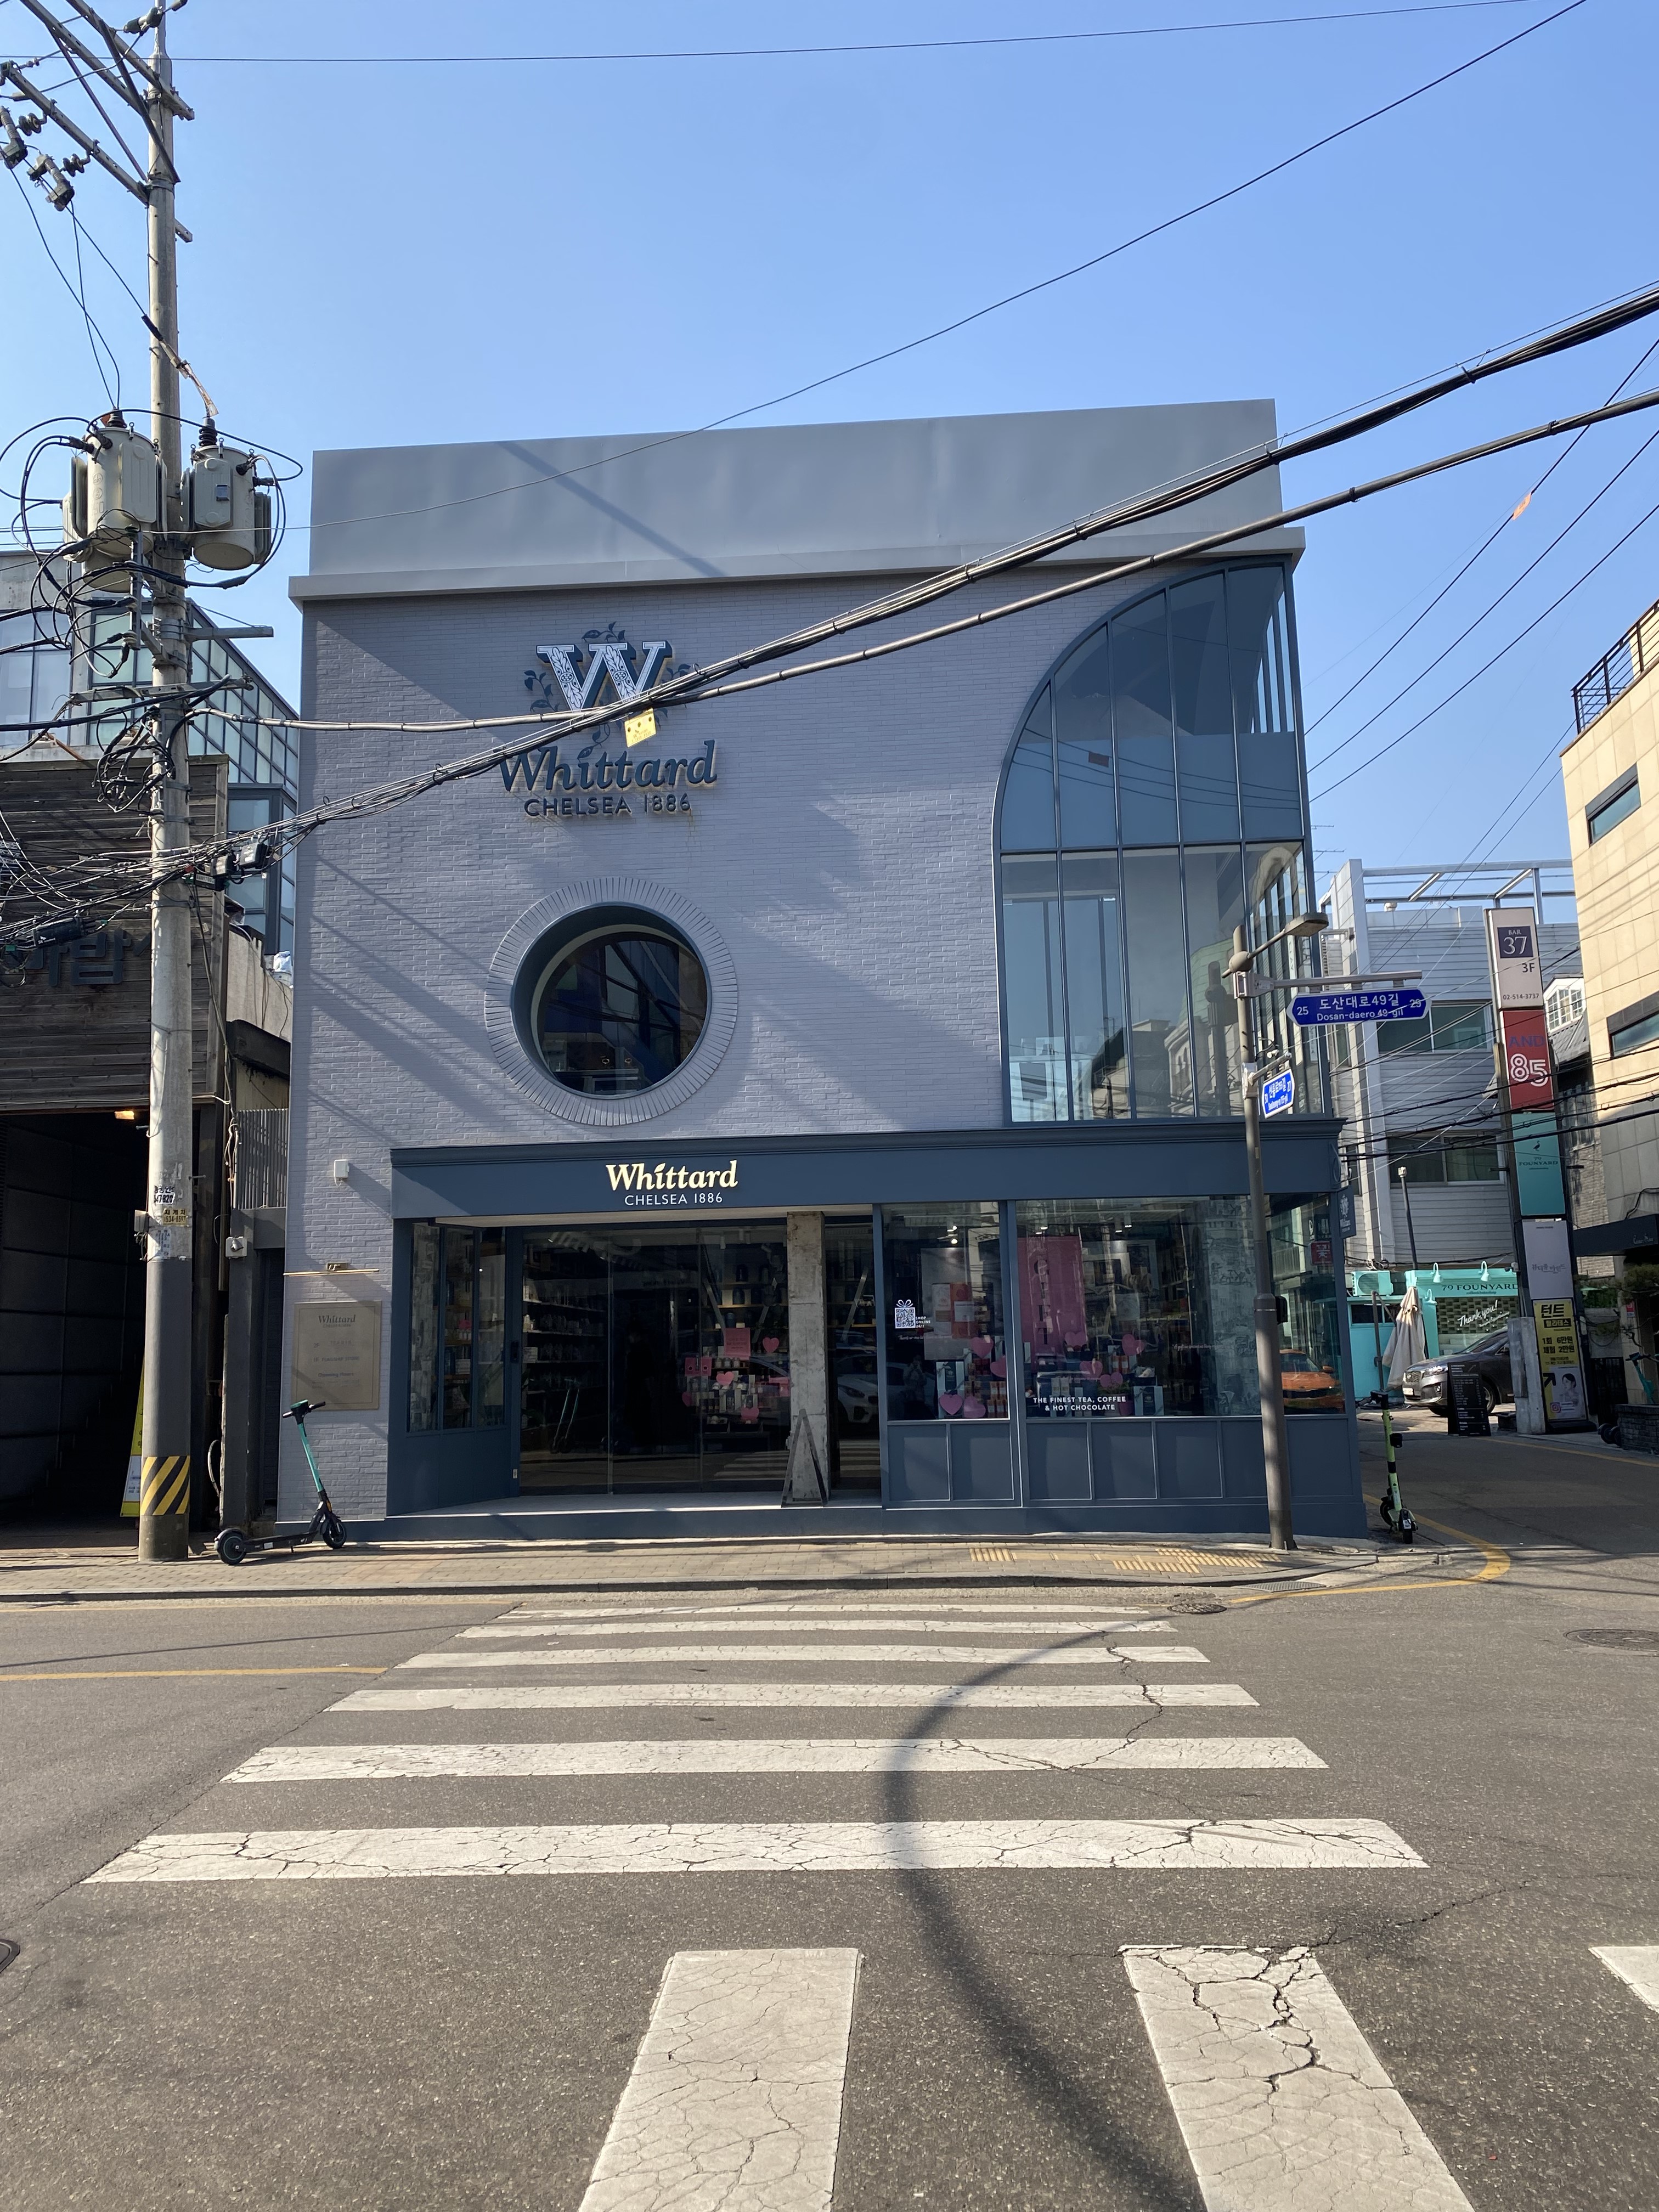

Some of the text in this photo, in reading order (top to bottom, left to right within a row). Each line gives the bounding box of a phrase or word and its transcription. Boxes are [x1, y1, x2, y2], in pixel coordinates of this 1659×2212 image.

[494, 740, 717, 792] Whittard
[524, 793, 691, 817] CHELSEA 1886
[1503, 936, 1527, 955] 37
[1522, 963, 1536, 973] 3F
[1297, 1006, 1309, 1015] 25
[1319, 994, 1399, 1010] 도산대로49길
[1317, 1011, 1375, 1022] Dosan-daero
[1509, 1035, 1545, 1048] AND
[1510, 1053, 1549, 1087] 85
[606, 1160, 738, 1190] Whittard
[624, 1192, 723, 1206] CHELSEA 1886
[318, 1314, 356, 1323] Whittard
[1457, 1309, 1482, 1327] Thank
[1481, 1300, 1498, 1319] you!
[1541, 1304, 1564, 1318] 턴트
